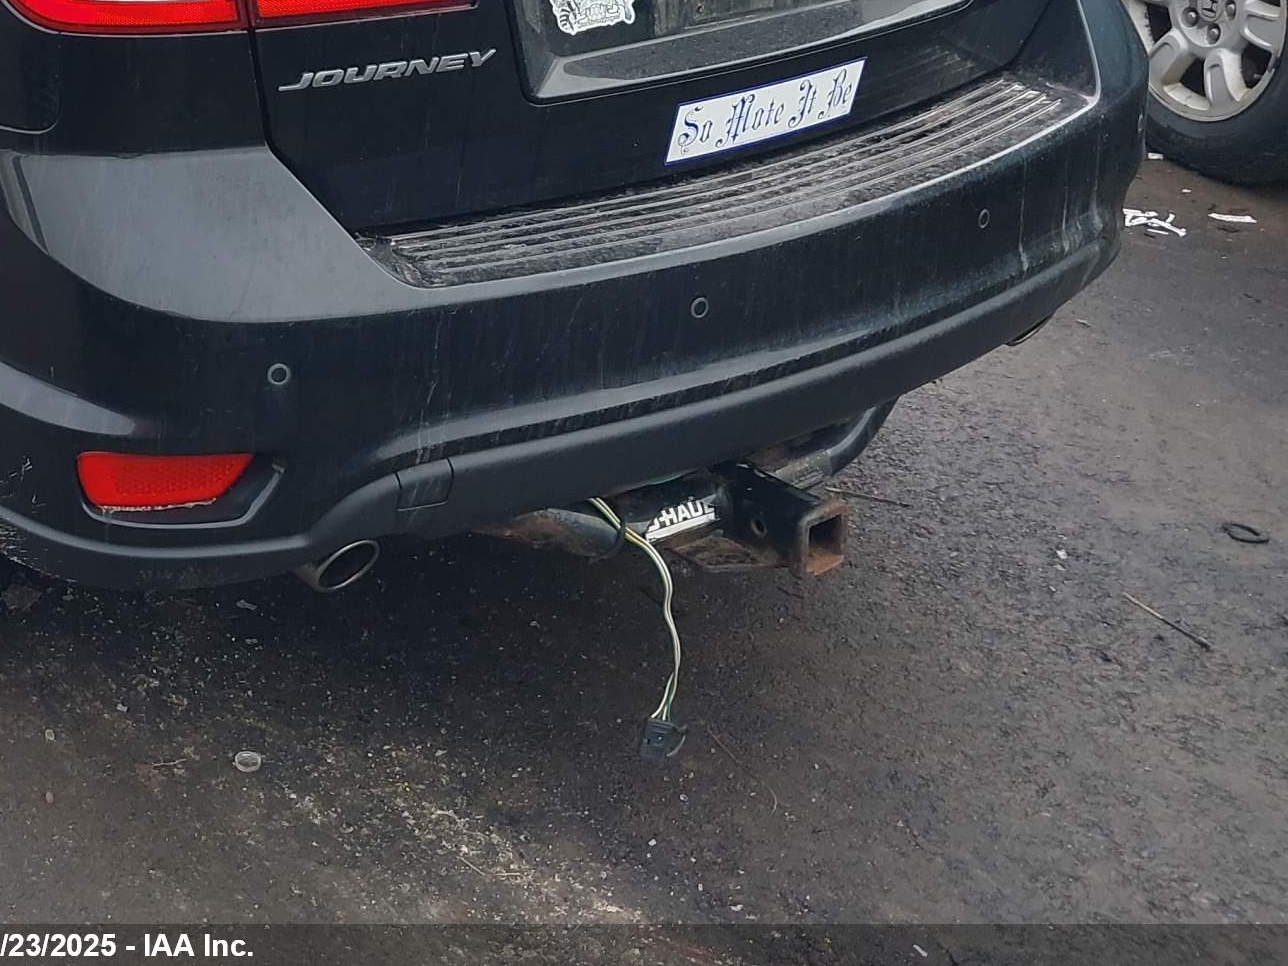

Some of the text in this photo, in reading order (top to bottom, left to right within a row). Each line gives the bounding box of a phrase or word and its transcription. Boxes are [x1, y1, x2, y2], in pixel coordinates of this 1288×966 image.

[278, 49, 497, 91] JOURNEY
[677, 68, 852, 154] So Mote It Be
